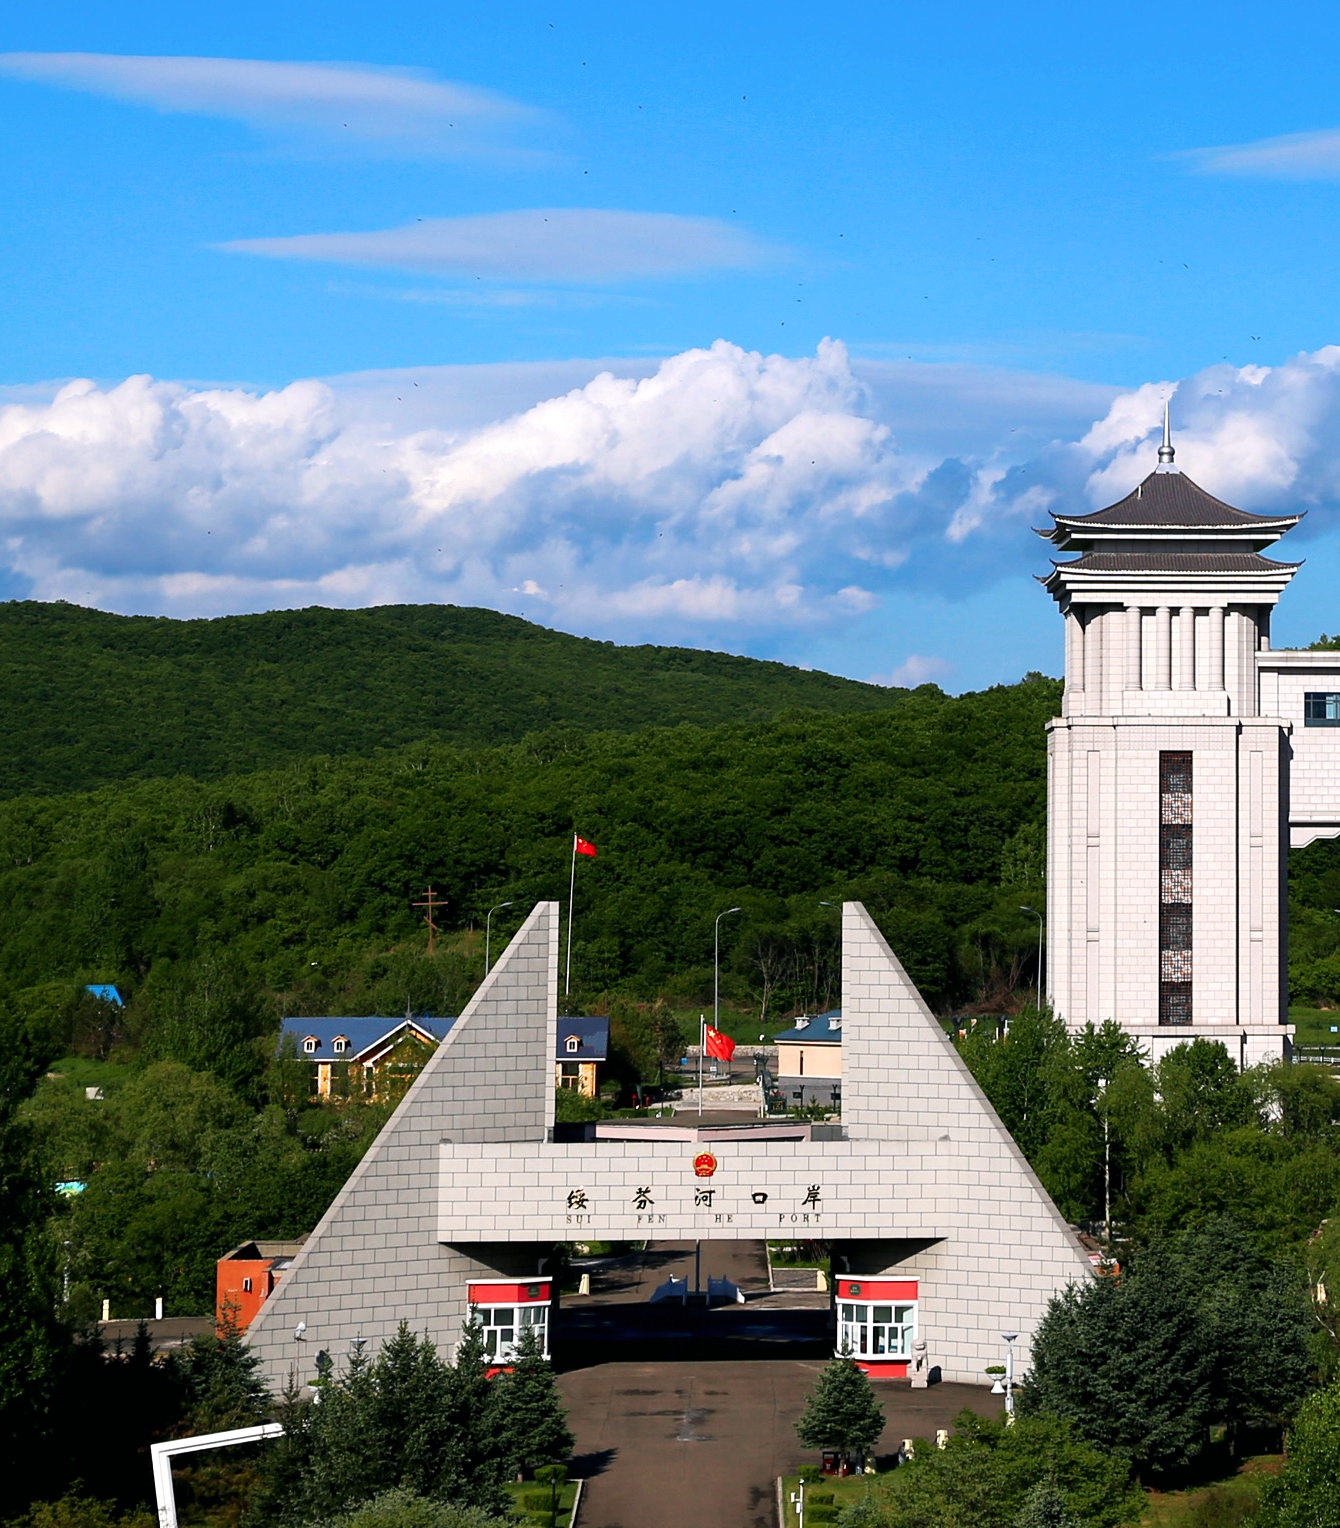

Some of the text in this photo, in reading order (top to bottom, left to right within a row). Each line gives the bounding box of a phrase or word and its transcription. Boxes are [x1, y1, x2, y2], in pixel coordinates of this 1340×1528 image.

[566, 1183, 822, 1210] 绥芬河口岸
[566, 1213, 821, 1224] SUI FEN HE PORT
